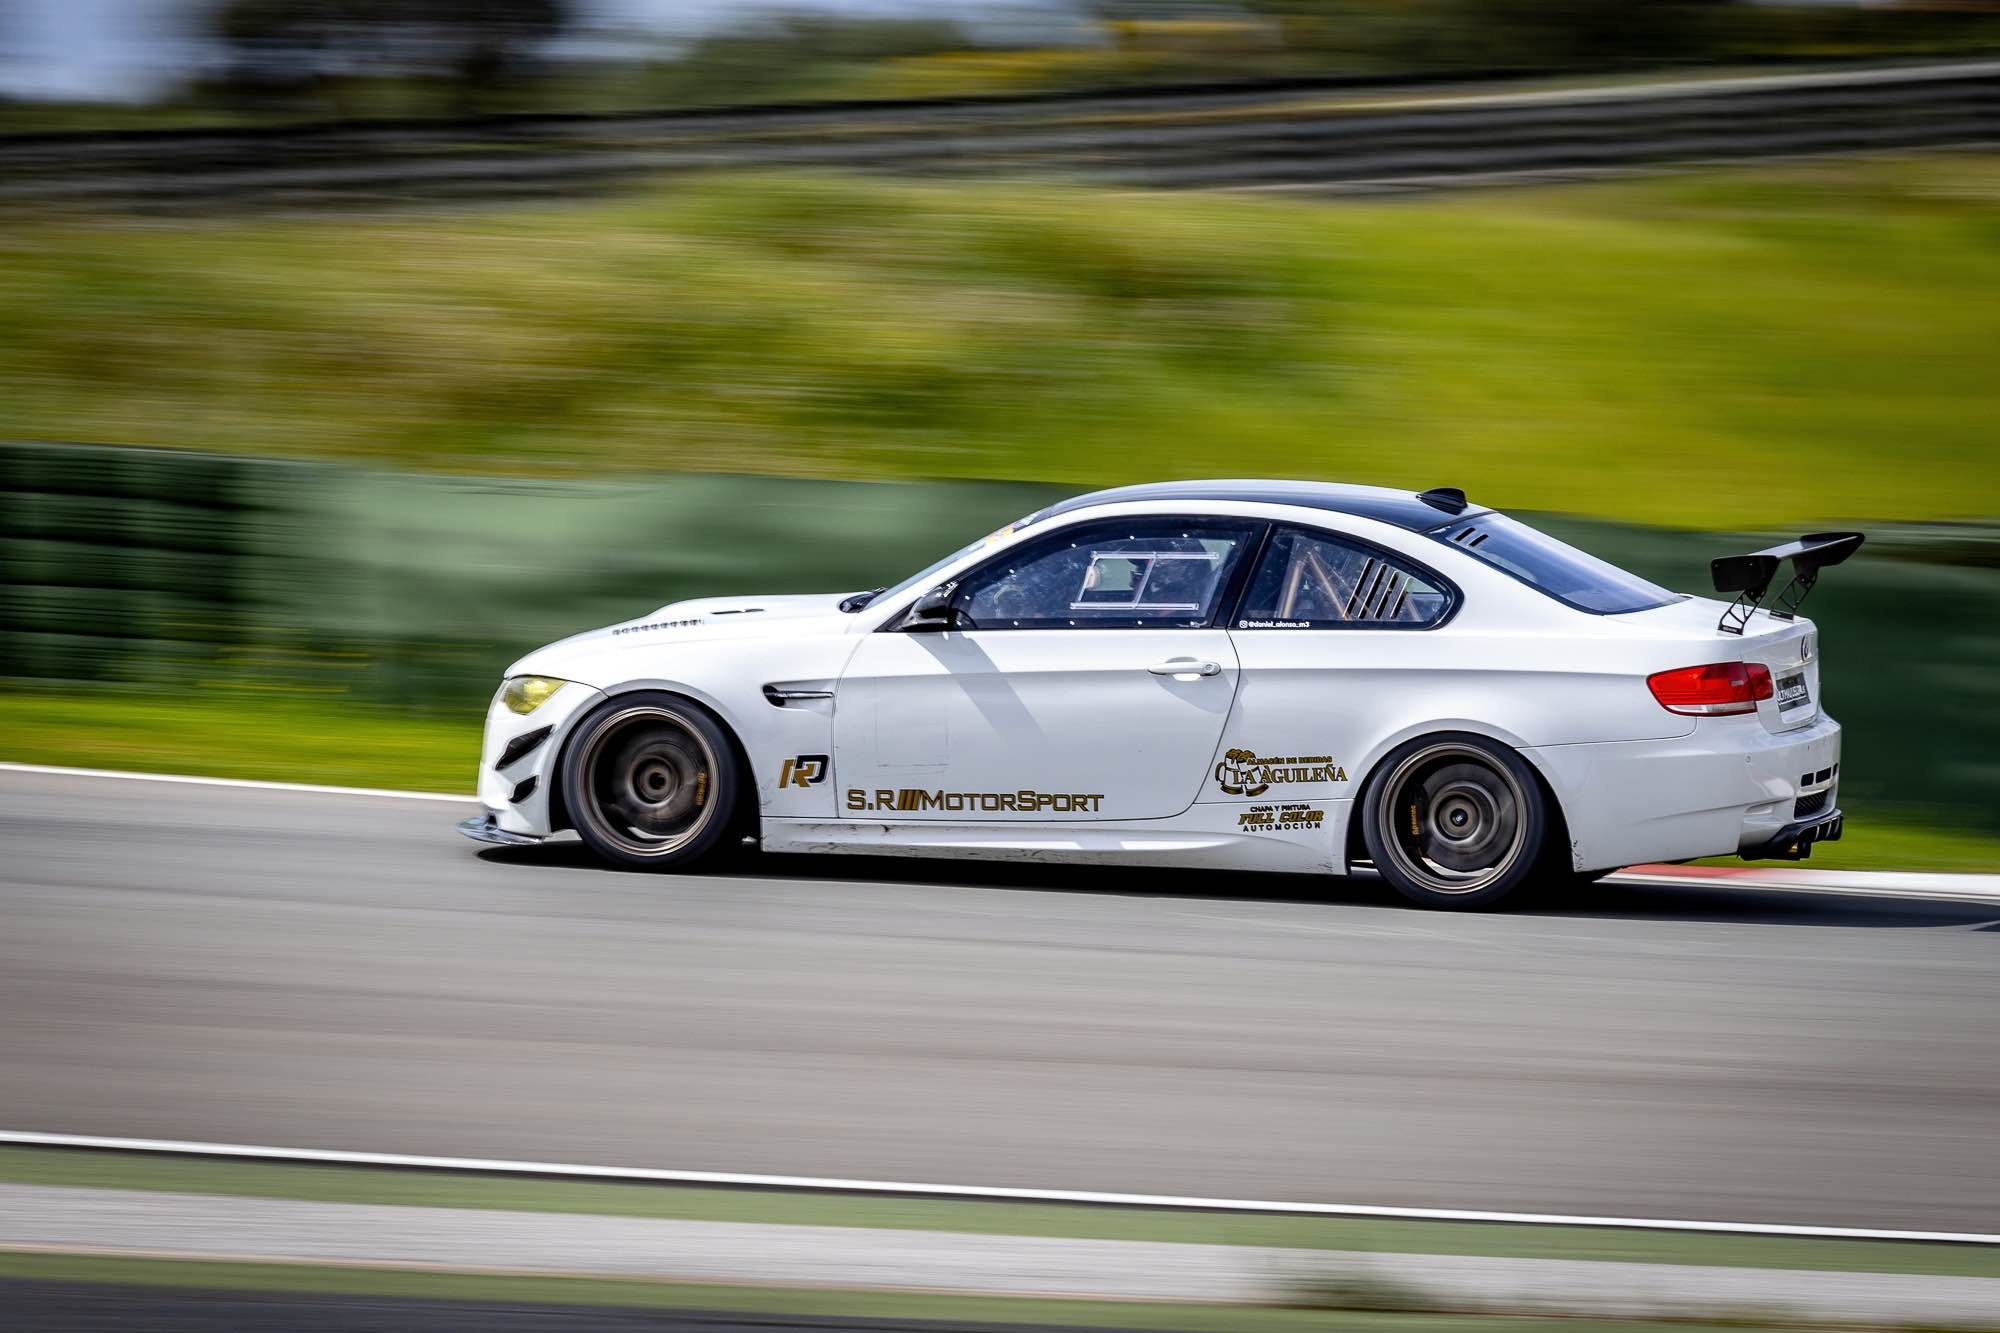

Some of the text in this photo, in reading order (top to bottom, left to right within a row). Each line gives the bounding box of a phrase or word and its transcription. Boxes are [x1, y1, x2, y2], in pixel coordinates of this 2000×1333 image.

[1233, 764, 1348, 785] LA AGUILEÑA
[1238, 811, 1324, 825] FULL COLOR
[1243, 822, 1321, 832] AUTOMOCIÓN
